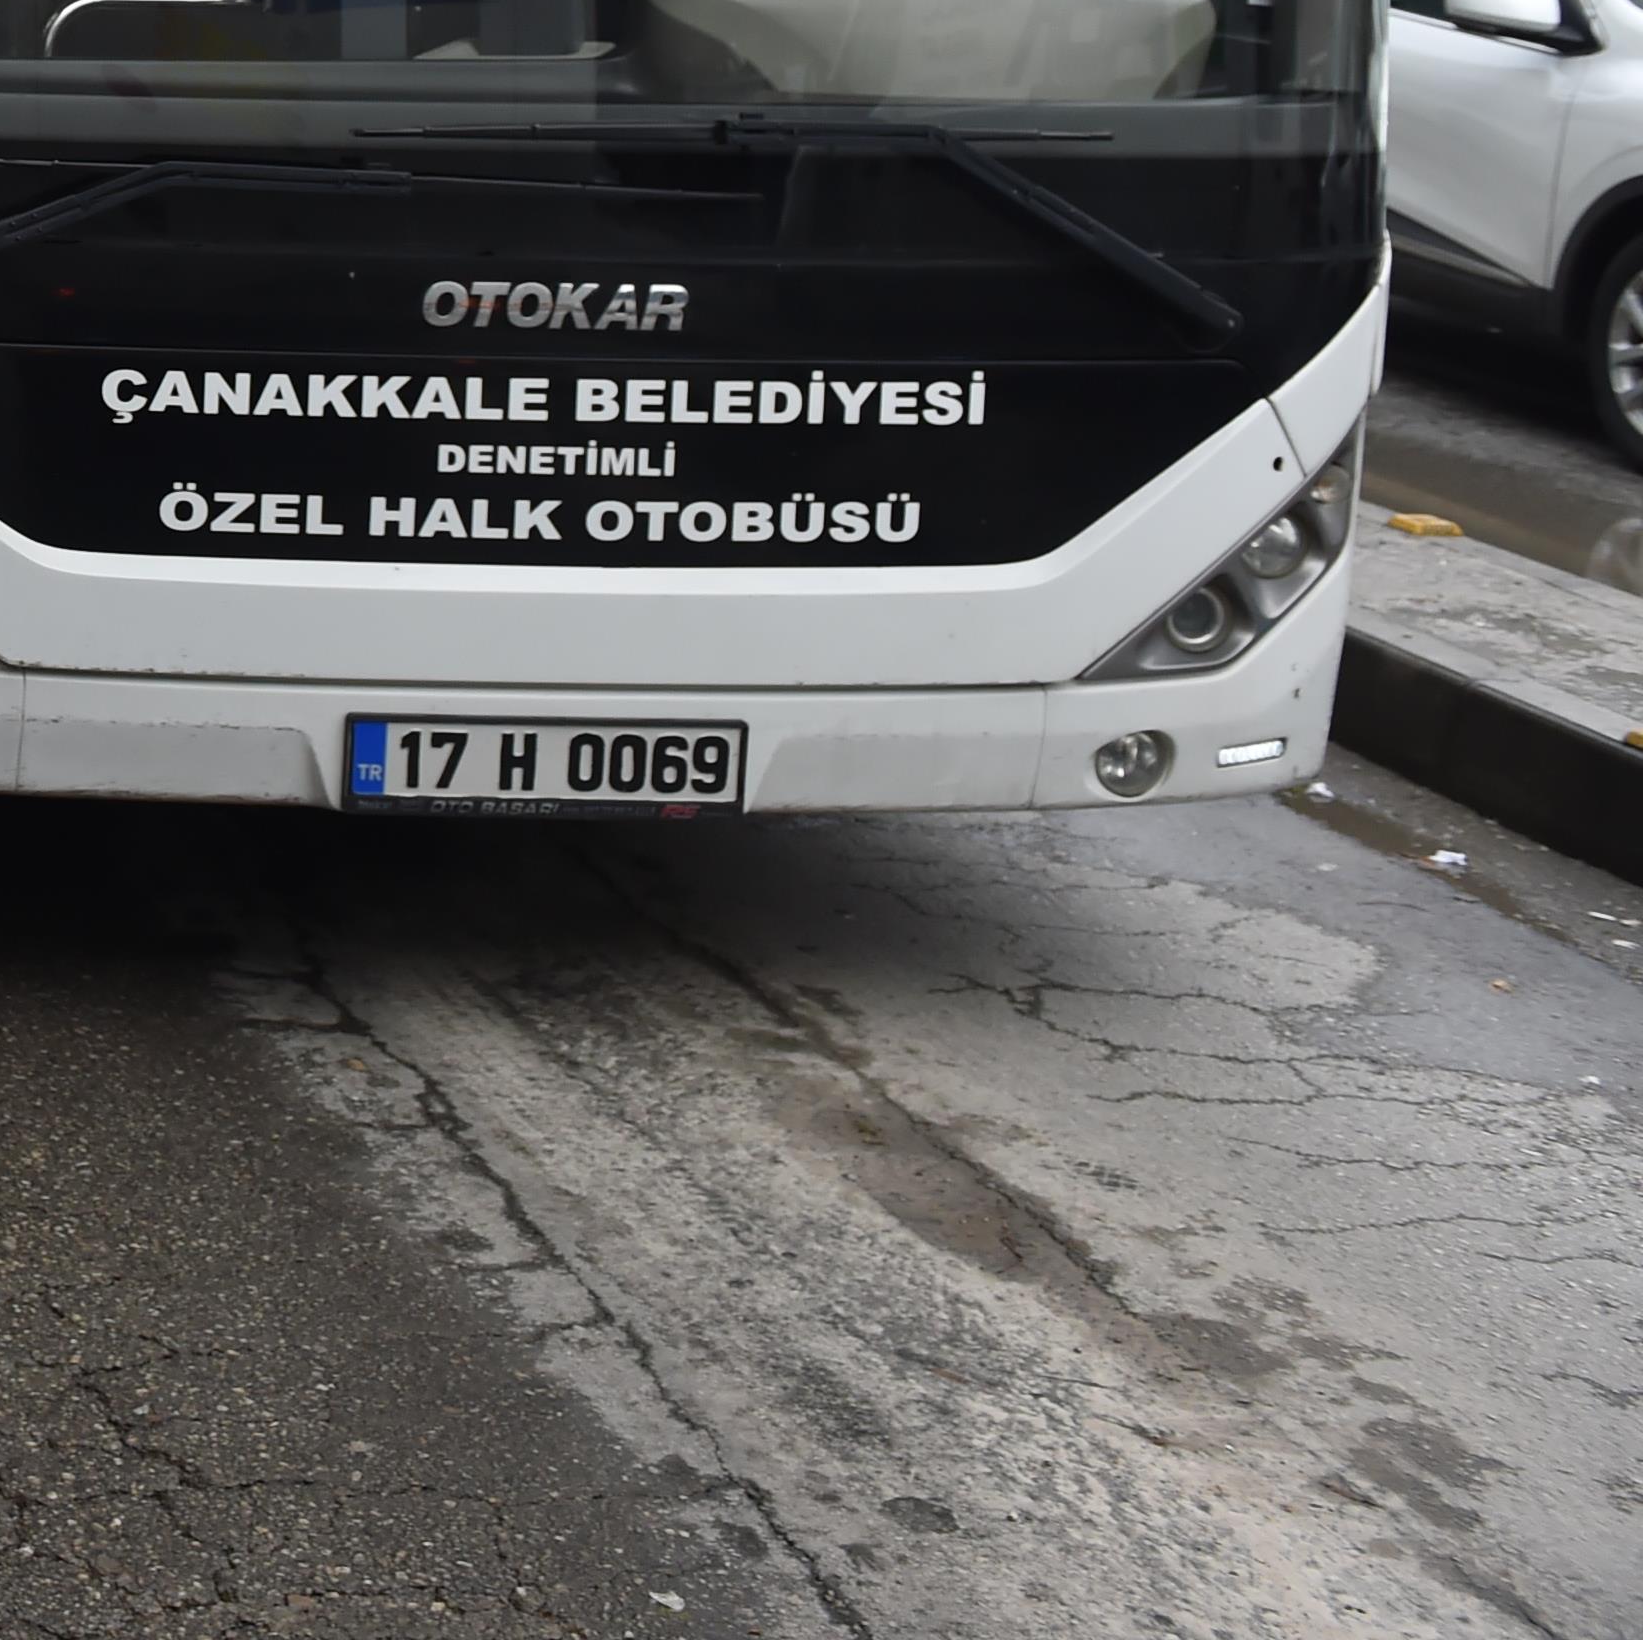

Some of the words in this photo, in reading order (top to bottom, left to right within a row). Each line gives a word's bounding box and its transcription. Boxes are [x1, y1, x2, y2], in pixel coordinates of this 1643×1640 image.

[421, 280, 689, 331] OTOKAR
[101, 368, 549, 424] ÇANAKKALE
[574, 370, 986, 426] BELEDİYESİ
[437, 439, 675, 477] DENETİMLİ
[158, 482, 343, 536] ÖZEL
[368, 496, 562, 541] HALK
[585, 493, 921, 543] OTOBÜSÜ
[357, 763, 383, 781] TR
[400, 730, 469, 789] 17
[498, 732, 538, 791] H
[567, 732, 730, 794] 0069
